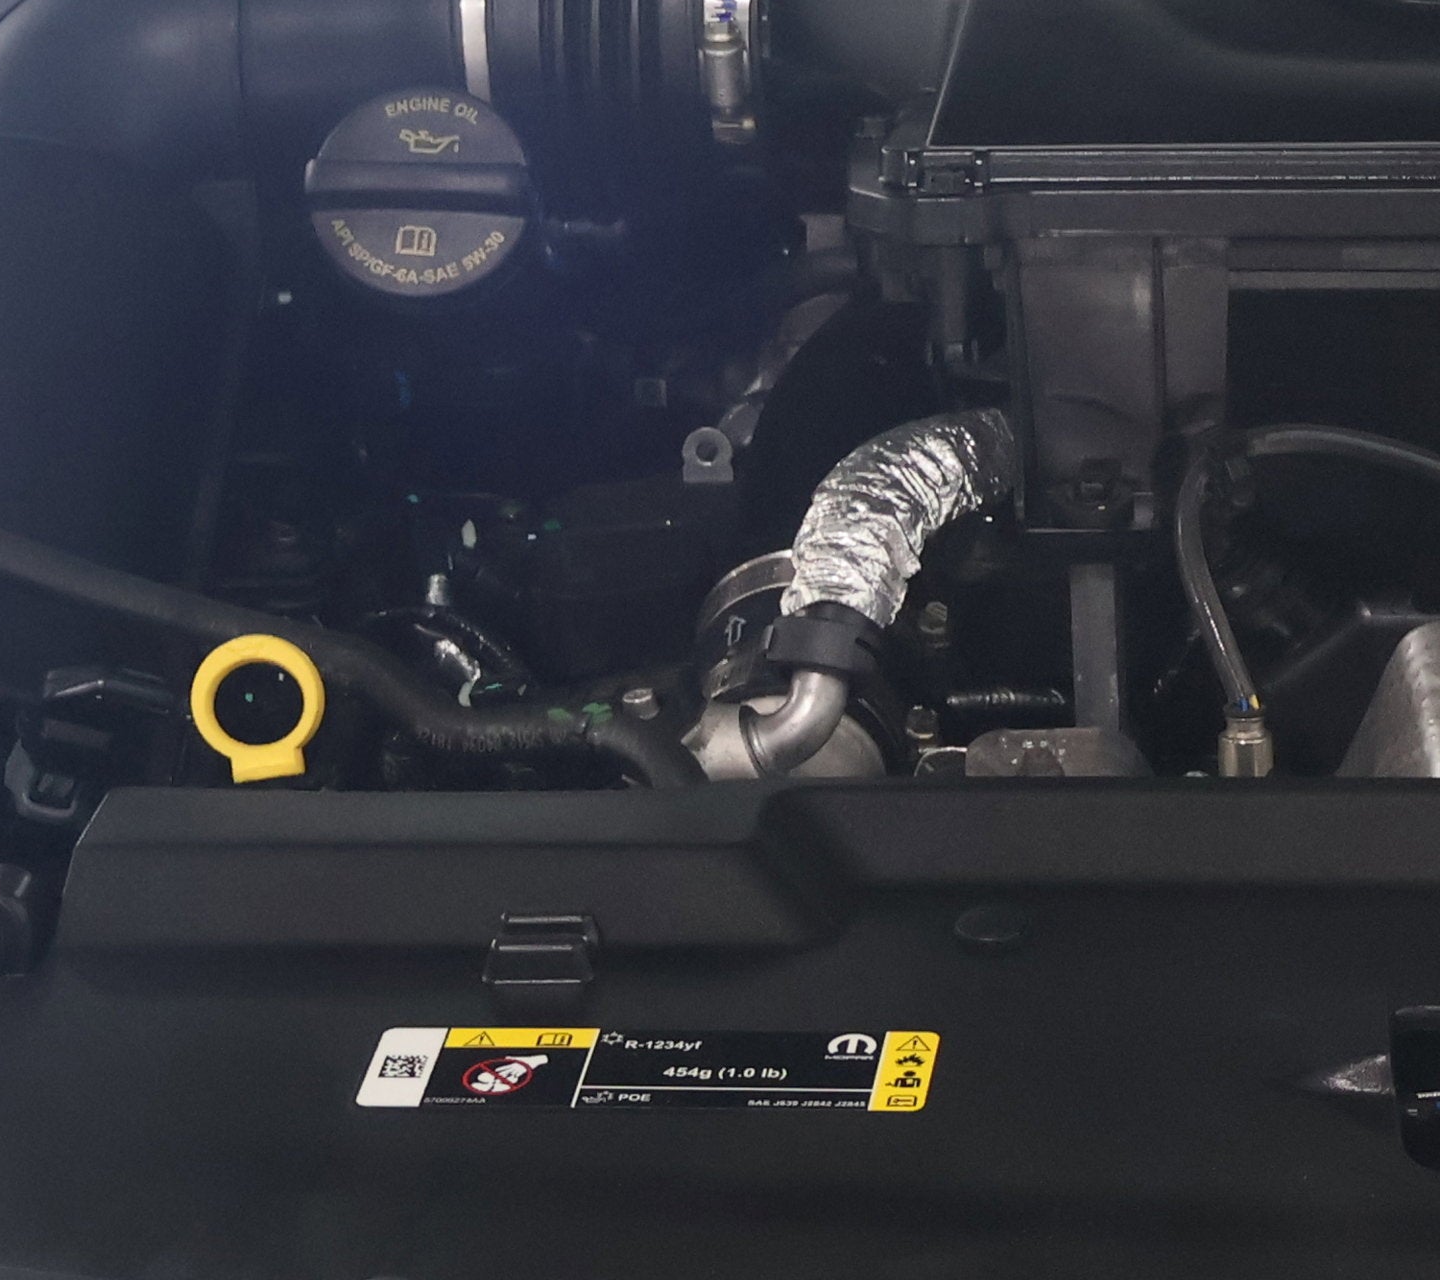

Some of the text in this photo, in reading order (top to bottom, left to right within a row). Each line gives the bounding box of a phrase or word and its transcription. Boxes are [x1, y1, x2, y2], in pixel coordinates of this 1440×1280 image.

[384, 97, 479, 125] ENGINE OIL
[331, 219, 356, 246] API
[462, 231, 505, 271] 5W-30
[624, 1040, 703, 1052] R-1234yf
[662, 1066, 788, 1081] 454g (1.0 lb)
[618, 1093, 652, 1102] POE
